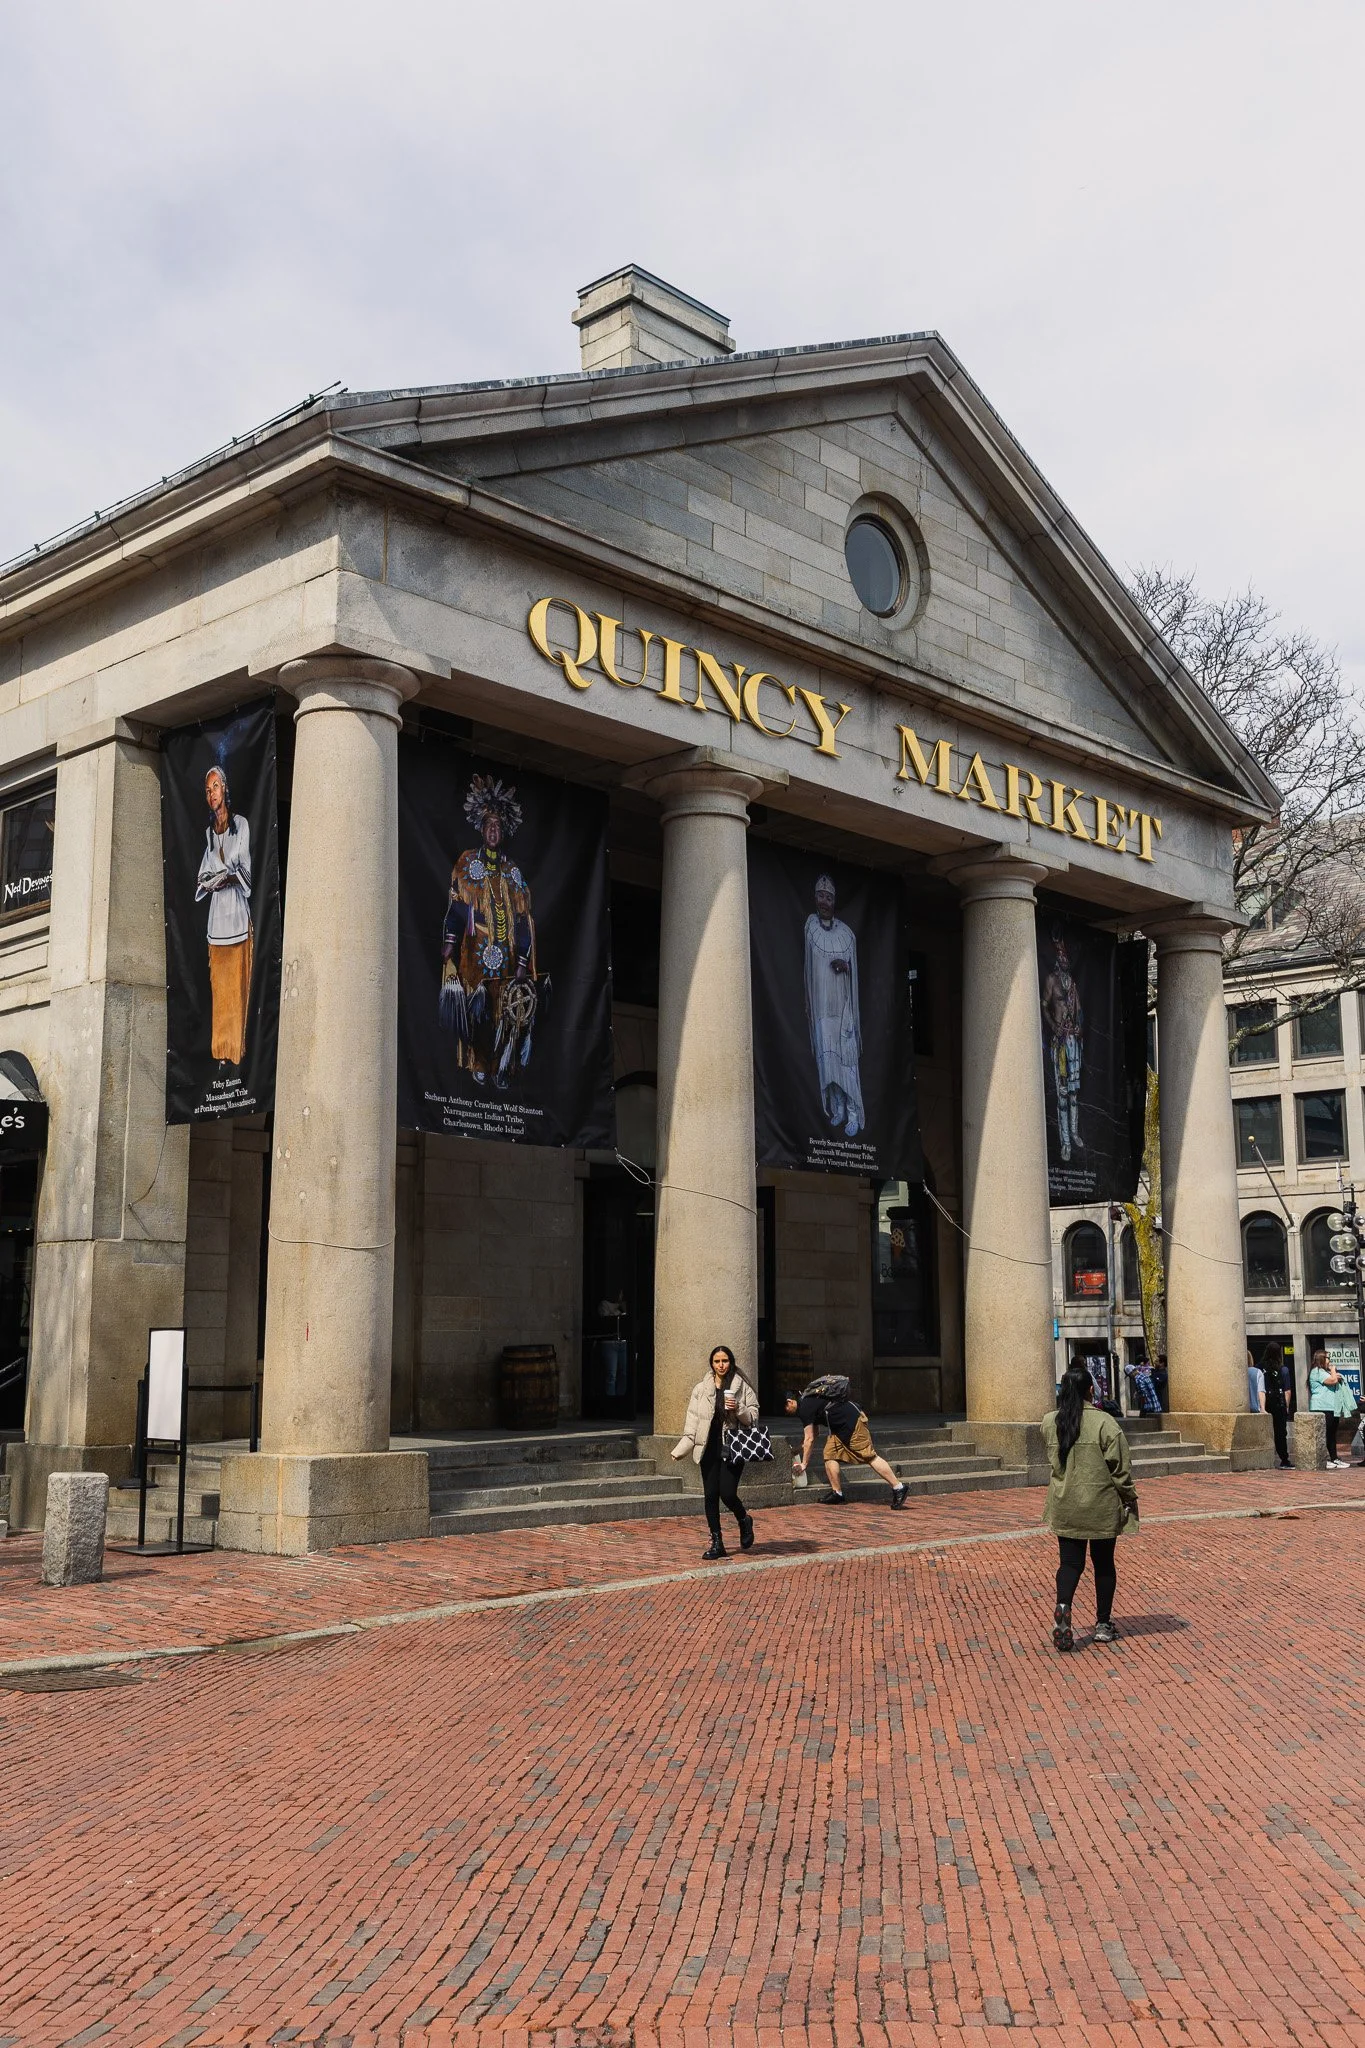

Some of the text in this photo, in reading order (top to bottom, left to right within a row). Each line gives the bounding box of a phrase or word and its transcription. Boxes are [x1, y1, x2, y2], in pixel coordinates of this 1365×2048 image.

[527, 597, 1163, 863] QUINCY MARKET
[4, 879, 21, 904] Ned
[212, 1081, 225, 1089] Toby
[235, 1088, 248, 1097] Tribe
[424, 1091, 543, 1116] Sachem Anthony Crawling Wolf Stanton
[443, 1106, 483, 1119] Narragansett
[484, 1112, 505, 1121] Indian
[484, 1123, 504, 1133] Rhode
[505, 1125, 525, 1135] Island
[809, 1137, 826, 1147] Beverly
[827, 1140, 845, 1149] Soaring
[845, 1141, 862, 1150] Feather
